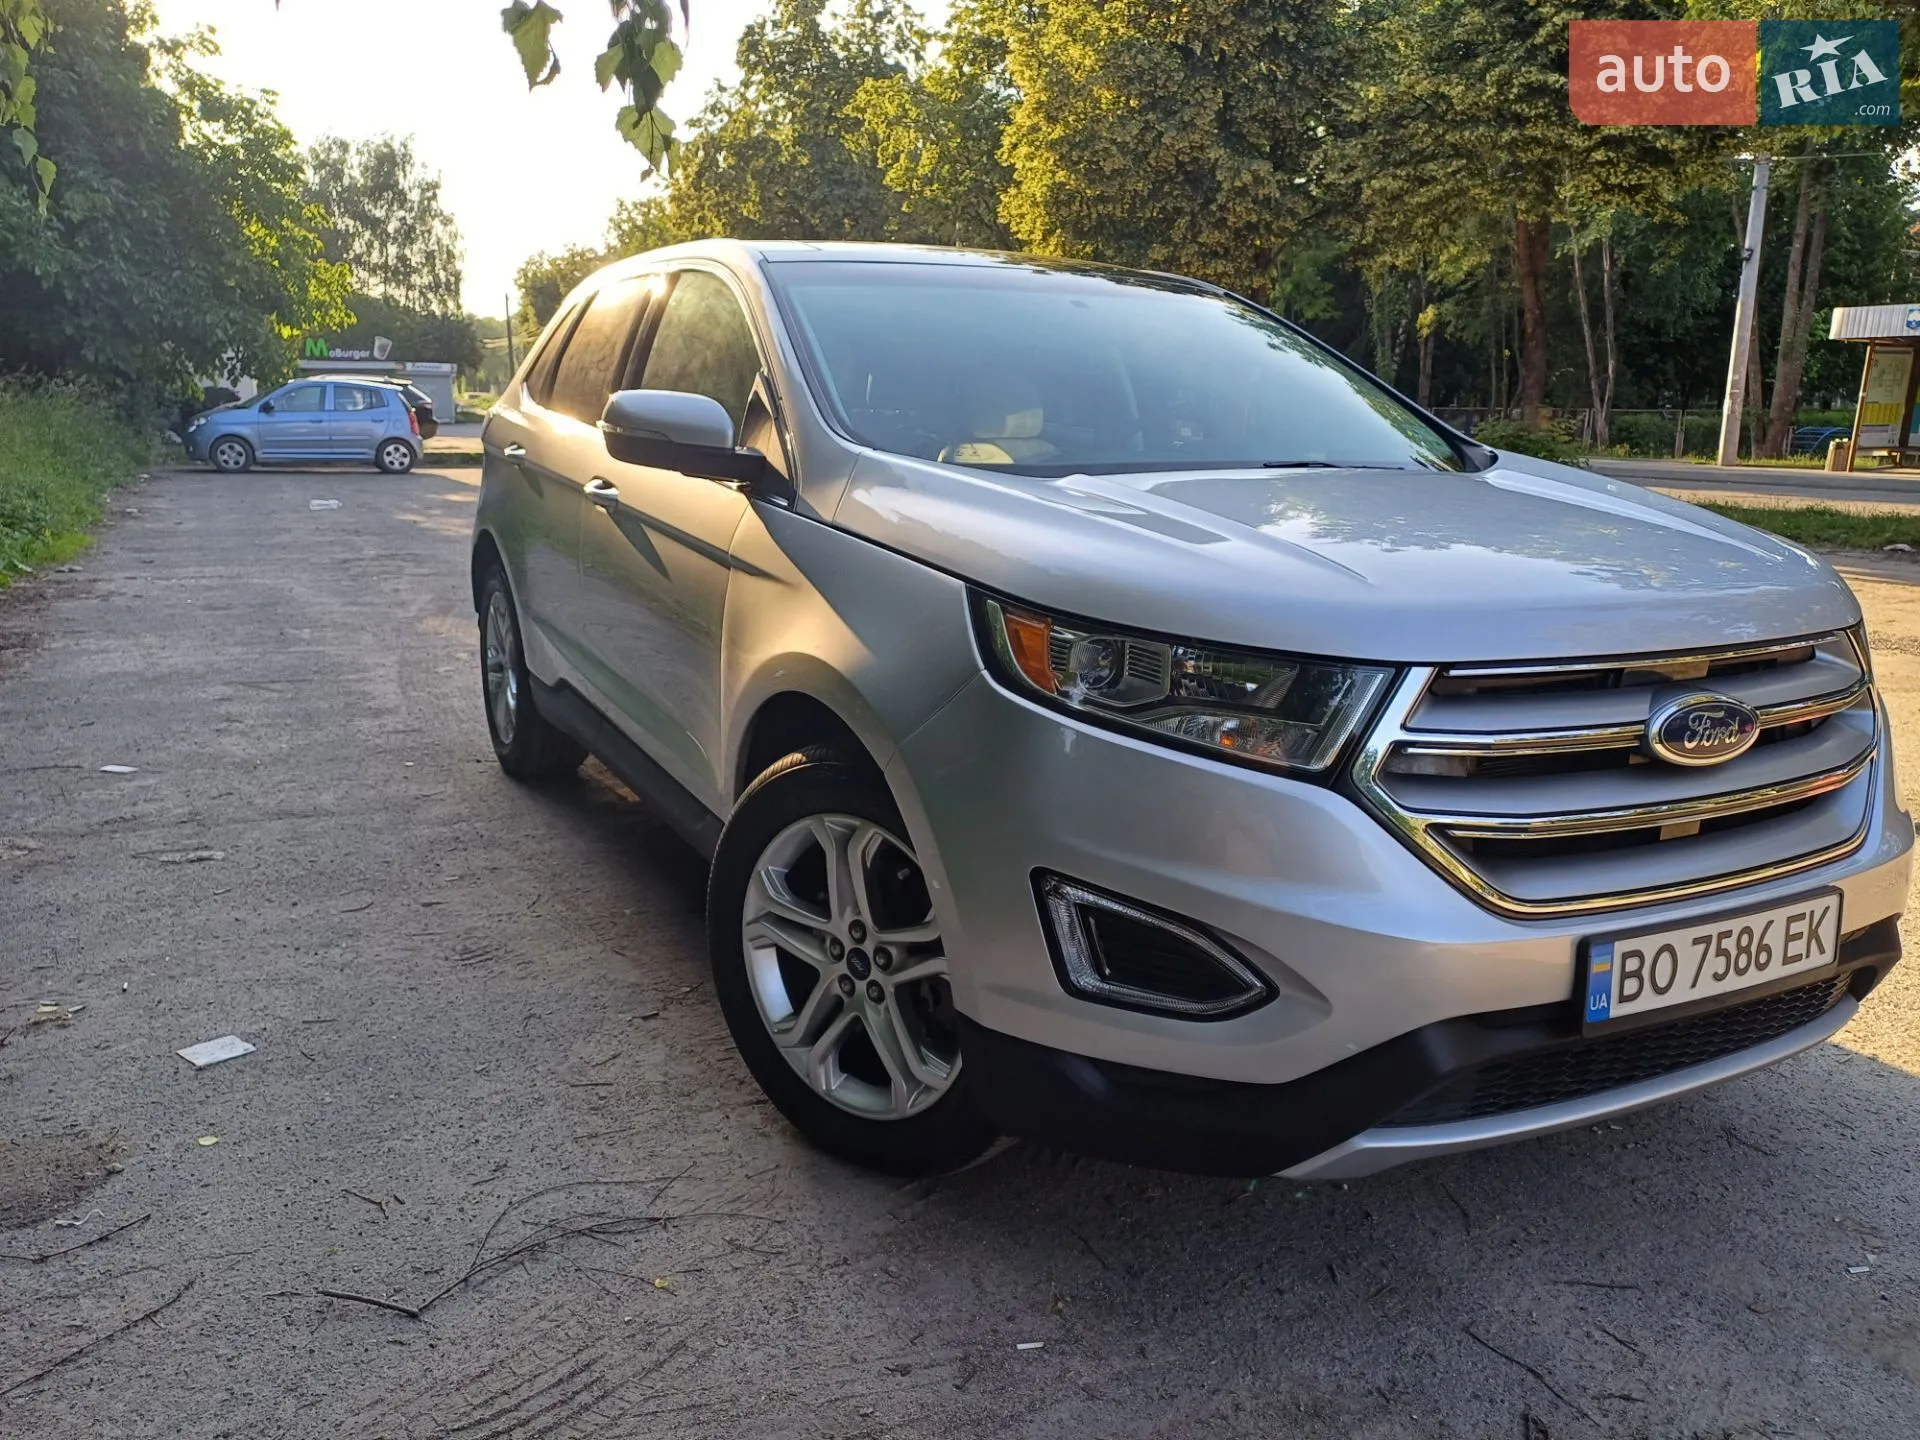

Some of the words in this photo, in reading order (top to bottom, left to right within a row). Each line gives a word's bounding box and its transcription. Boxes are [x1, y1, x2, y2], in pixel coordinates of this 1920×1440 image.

[305, 336, 370, 359] MoBurger
[1684, 710, 1741, 750] Ford
[1618, 943, 1679, 1004] BO
[1690, 919, 1775, 990] 7586
[1782, 905, 1831, 967] EK
[1589, 993, 1608, 1011] UA
